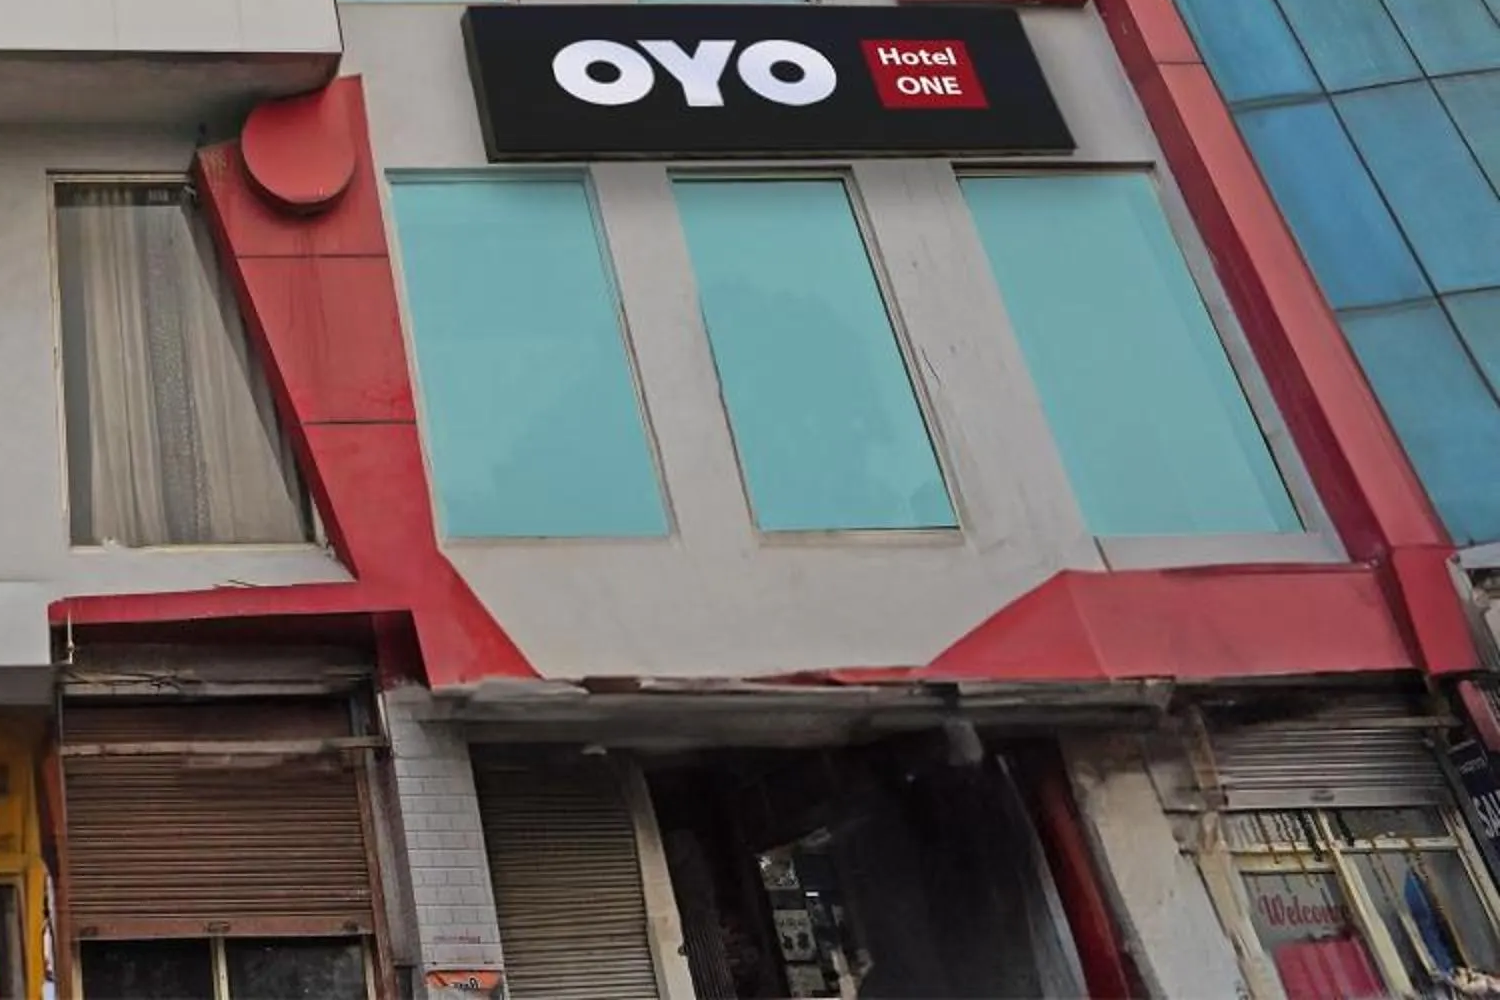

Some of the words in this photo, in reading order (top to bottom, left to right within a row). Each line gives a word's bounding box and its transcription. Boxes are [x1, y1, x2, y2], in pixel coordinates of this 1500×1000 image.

[877, 47, 957, 66] Hotel
[552, 39, 837, 106] OYO
[896, 76, 963, 96] ONE
